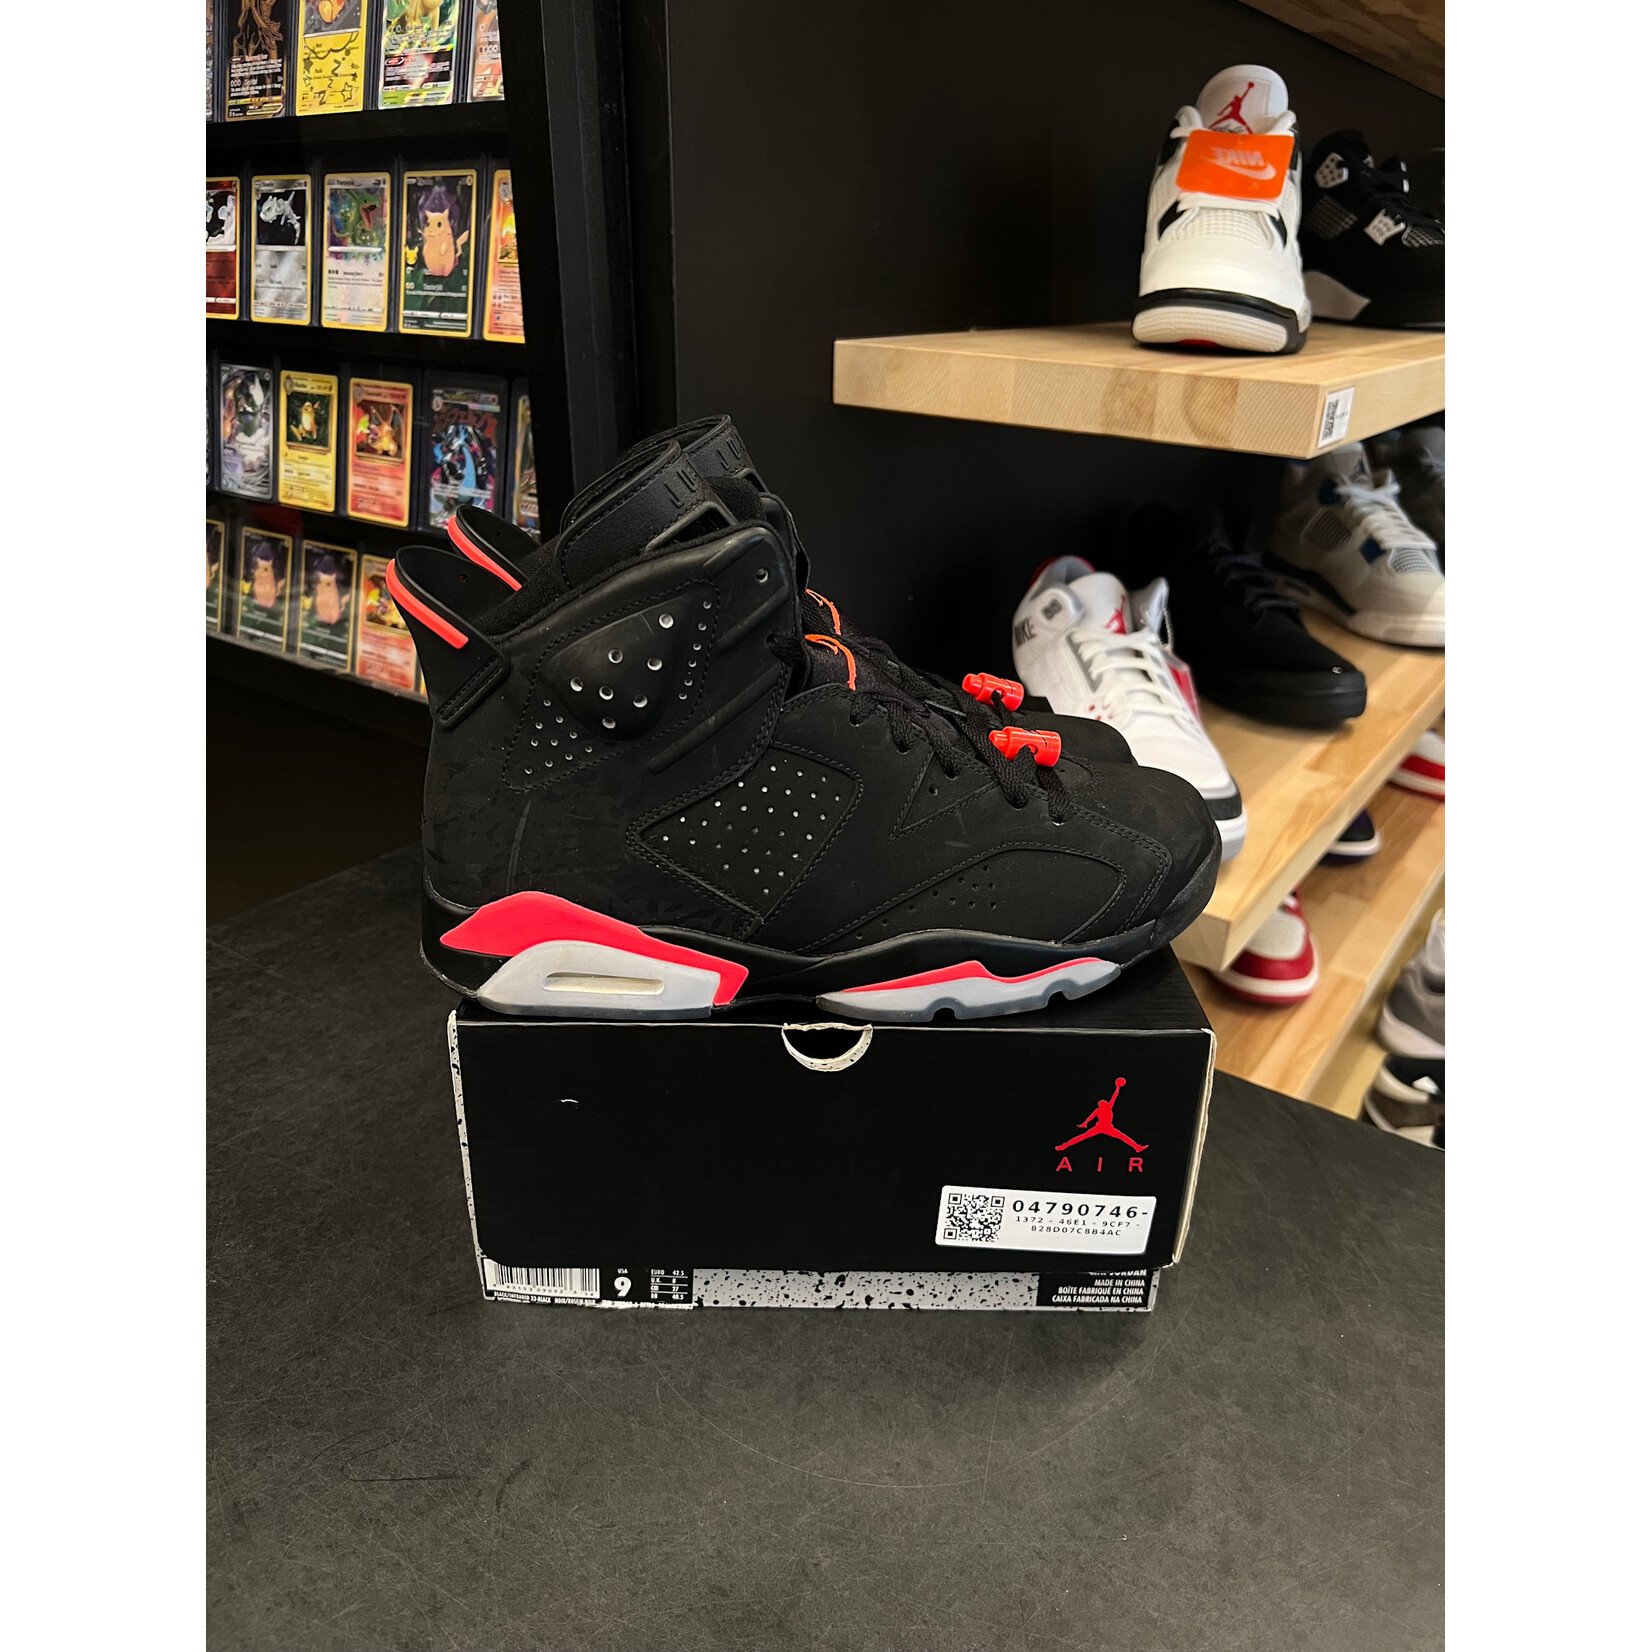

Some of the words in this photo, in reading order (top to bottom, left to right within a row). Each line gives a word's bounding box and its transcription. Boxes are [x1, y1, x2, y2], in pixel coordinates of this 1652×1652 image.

[1056, 1156, 1144, 1173] AIR
[1012, 1199, 1148, 1219] 04790746-
[614, 1276, 632, 1298] 9
[1094, 1279, 1114, 1287] MADE
[1115, 1279, 1123, 1287] IN
[1124, 1279, 1145, 1287] CHINA
[1112, 1287, 1122, 1295] EN
[1122, 1287, 1144, 1295] CHINA
[1052, 1294, 1072, 1303] CAIXA
[1073, 1295, 1109, 1303] FABRICADA
[1121, 1296, 1142, 1304] CHINA
